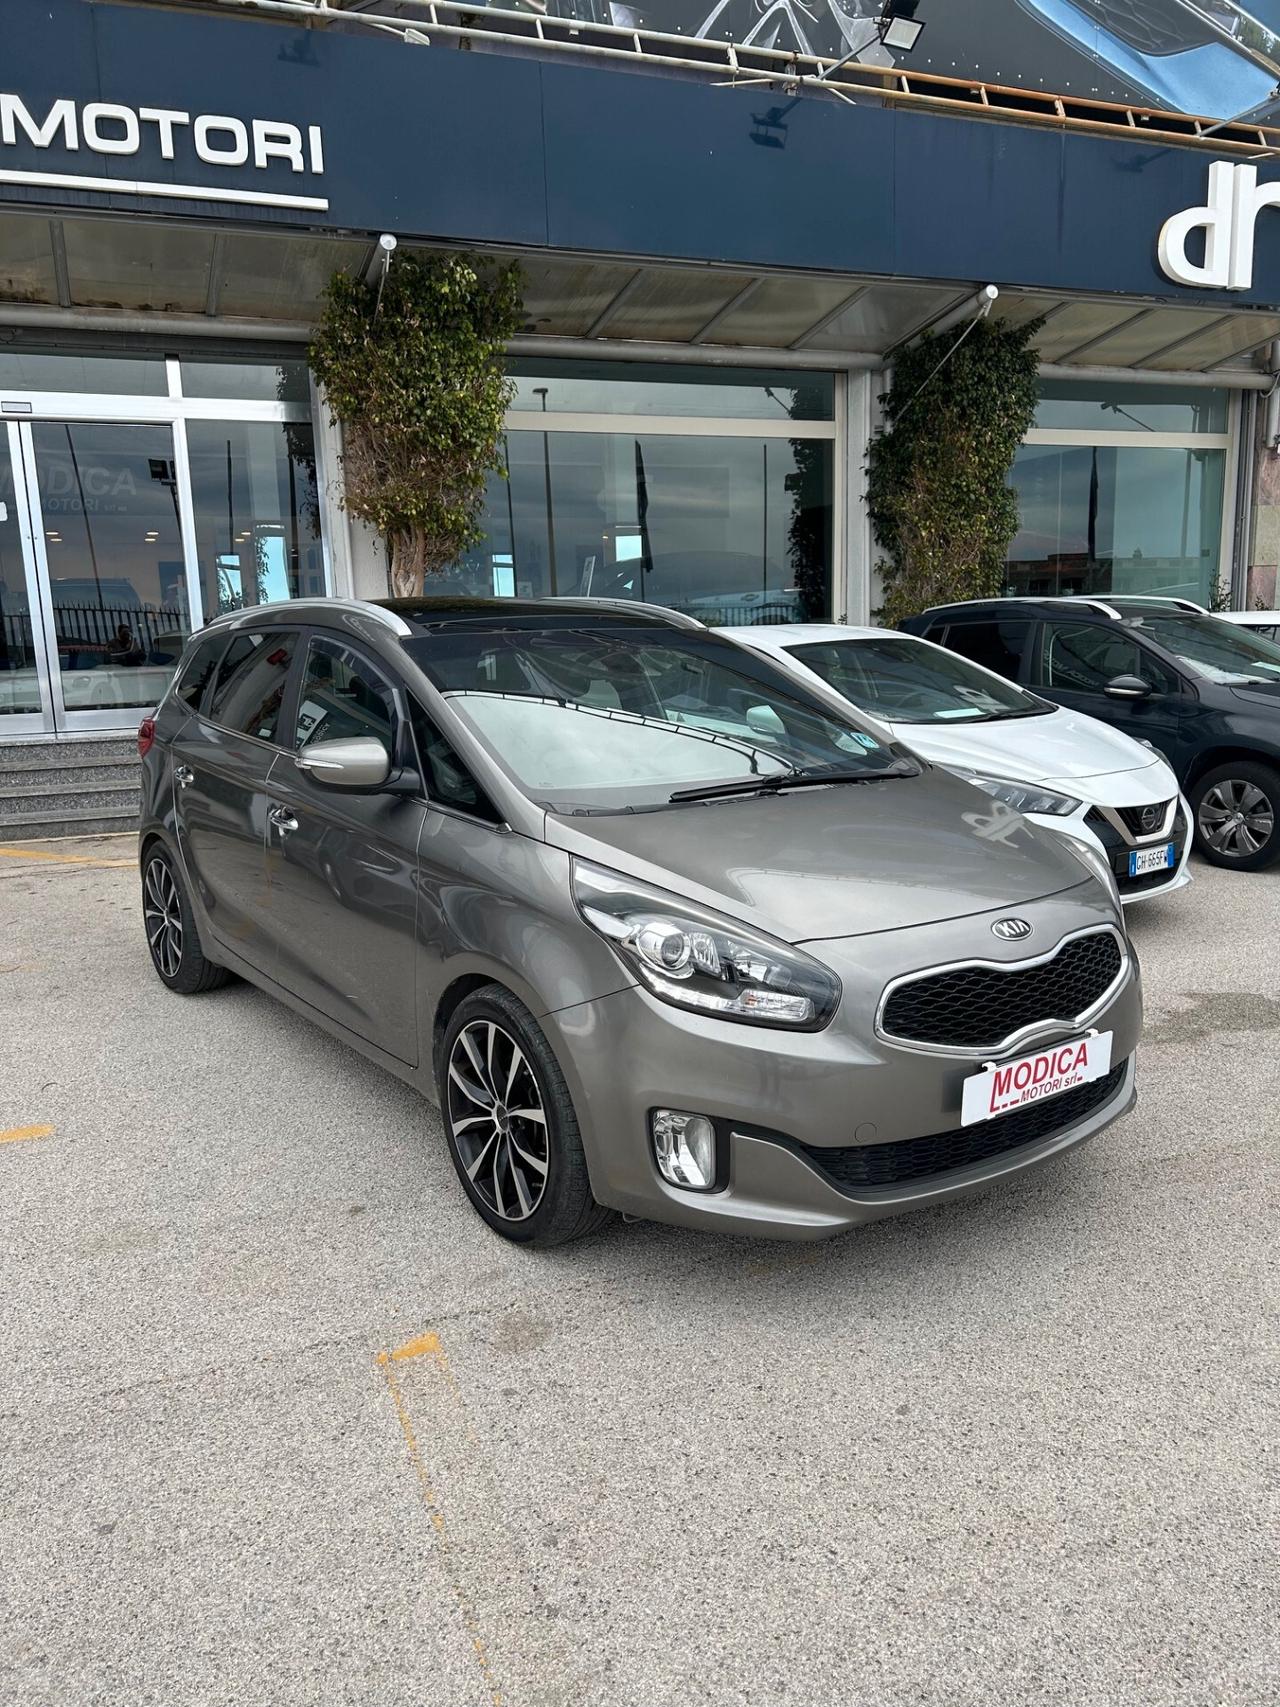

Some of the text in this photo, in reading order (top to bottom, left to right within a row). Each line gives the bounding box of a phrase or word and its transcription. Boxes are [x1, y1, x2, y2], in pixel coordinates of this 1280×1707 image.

[0, 94, 324, 174] MOTORI
[997, 918, 1030, 937] KIA
[990, 1043, 1088, 1100] MODICA
[1020, 1079, 1062, 1102] MOTORI
